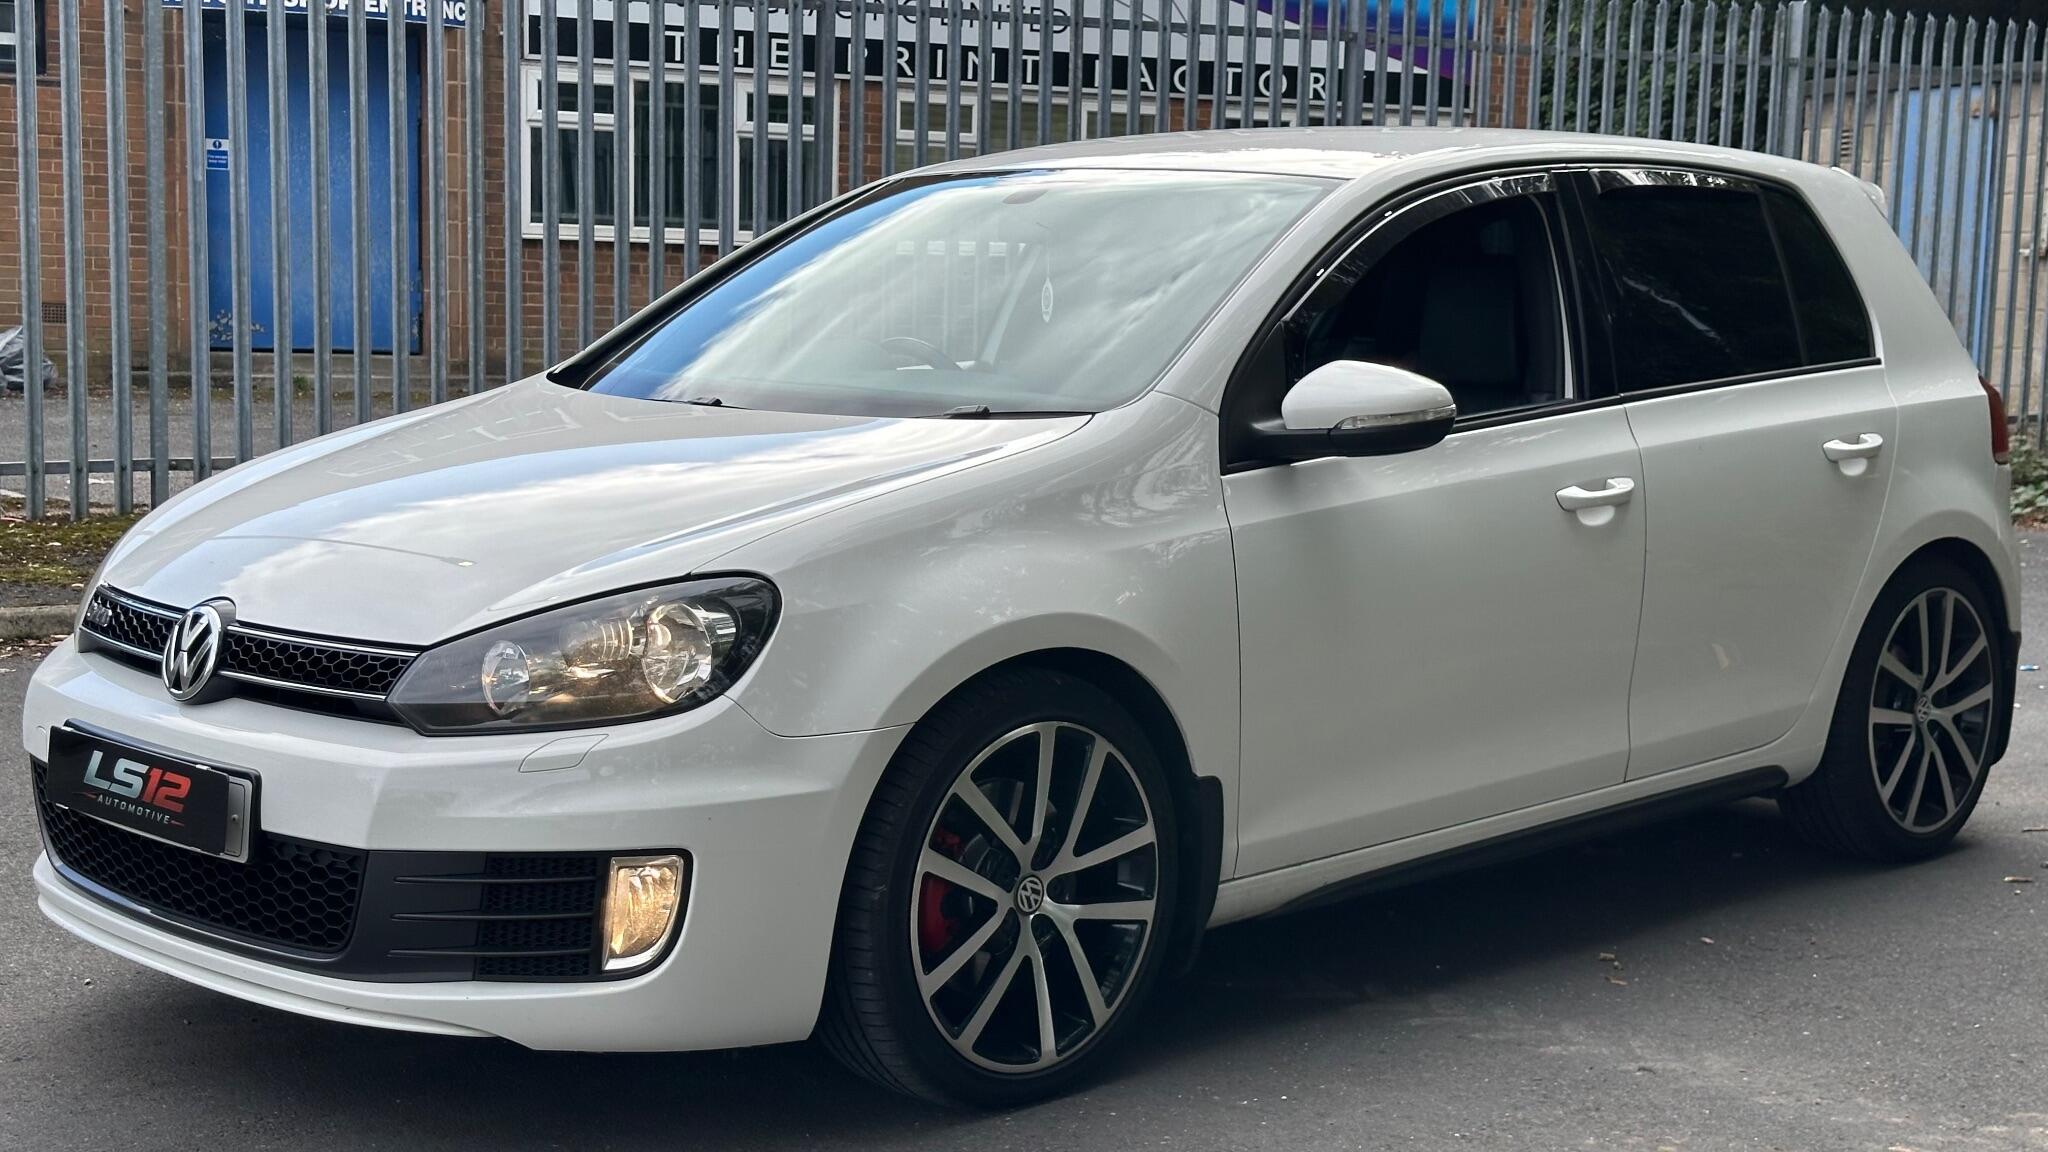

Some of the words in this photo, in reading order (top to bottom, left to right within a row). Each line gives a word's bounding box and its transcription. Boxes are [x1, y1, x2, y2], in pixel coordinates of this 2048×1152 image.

[664, 31, 790, 68] THE
[84, 750, 191, 813] LS12
[98, 795, 170, 824] AUTOMOTIVE
